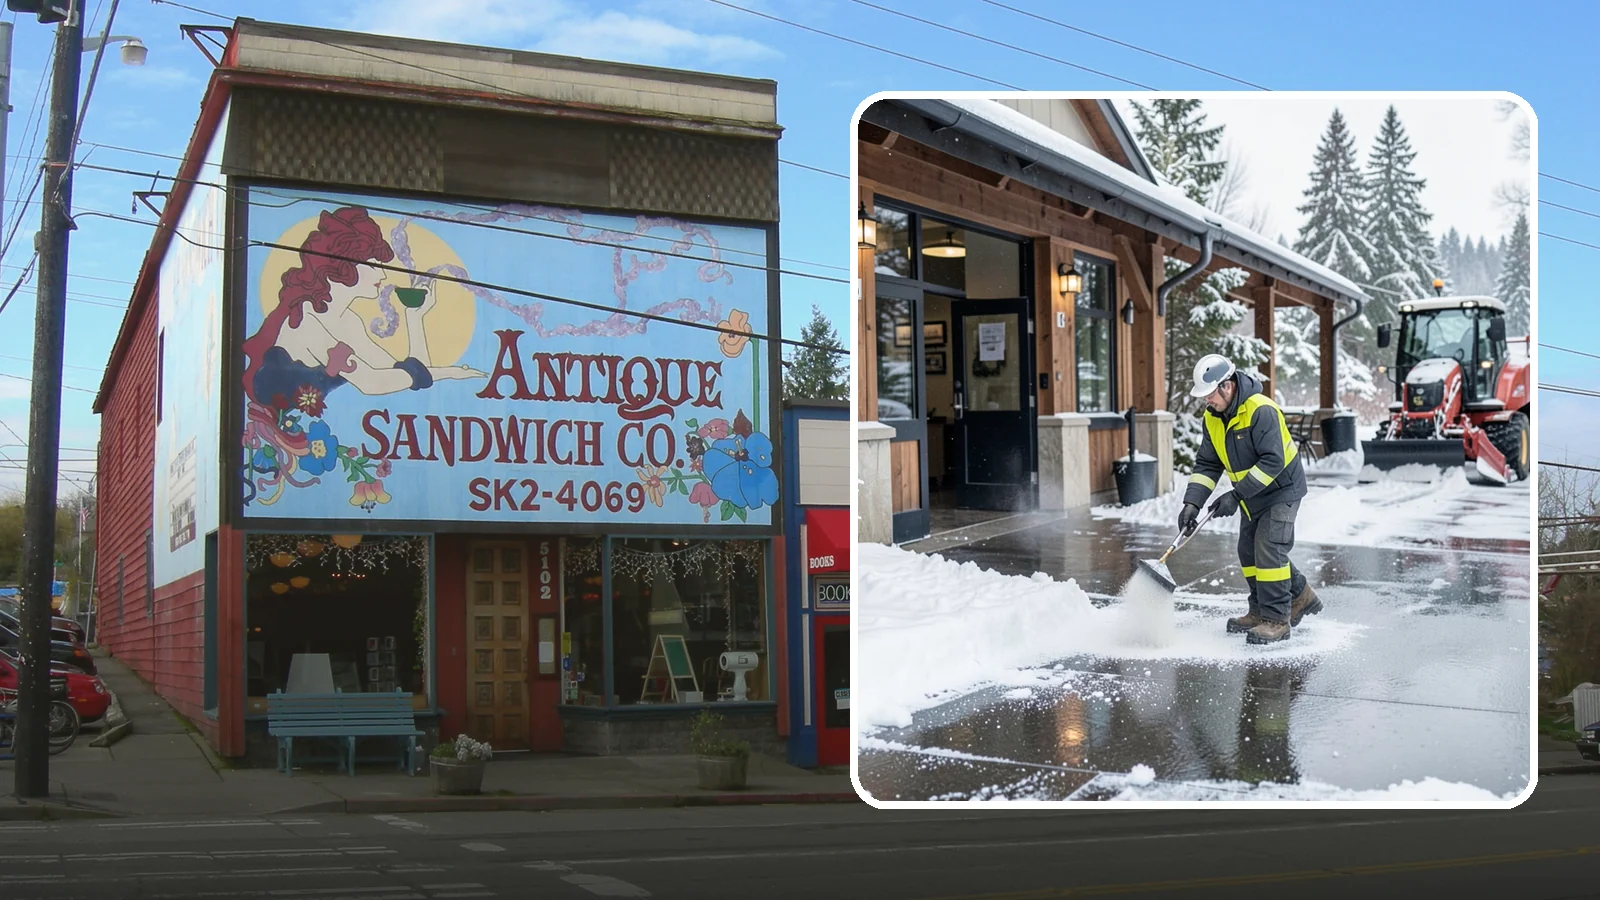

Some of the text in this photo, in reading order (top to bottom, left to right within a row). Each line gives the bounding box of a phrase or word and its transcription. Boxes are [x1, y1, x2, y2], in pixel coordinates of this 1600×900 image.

[476, 329, 723, 421] ANTIQUE
[361, 409, 684, 469] SANDWICH CO.
[468, 478, 645, 512] SK2-4069
[540, 541, 551, 599] 5102
[809, 555, 835, 568] BOOKS
